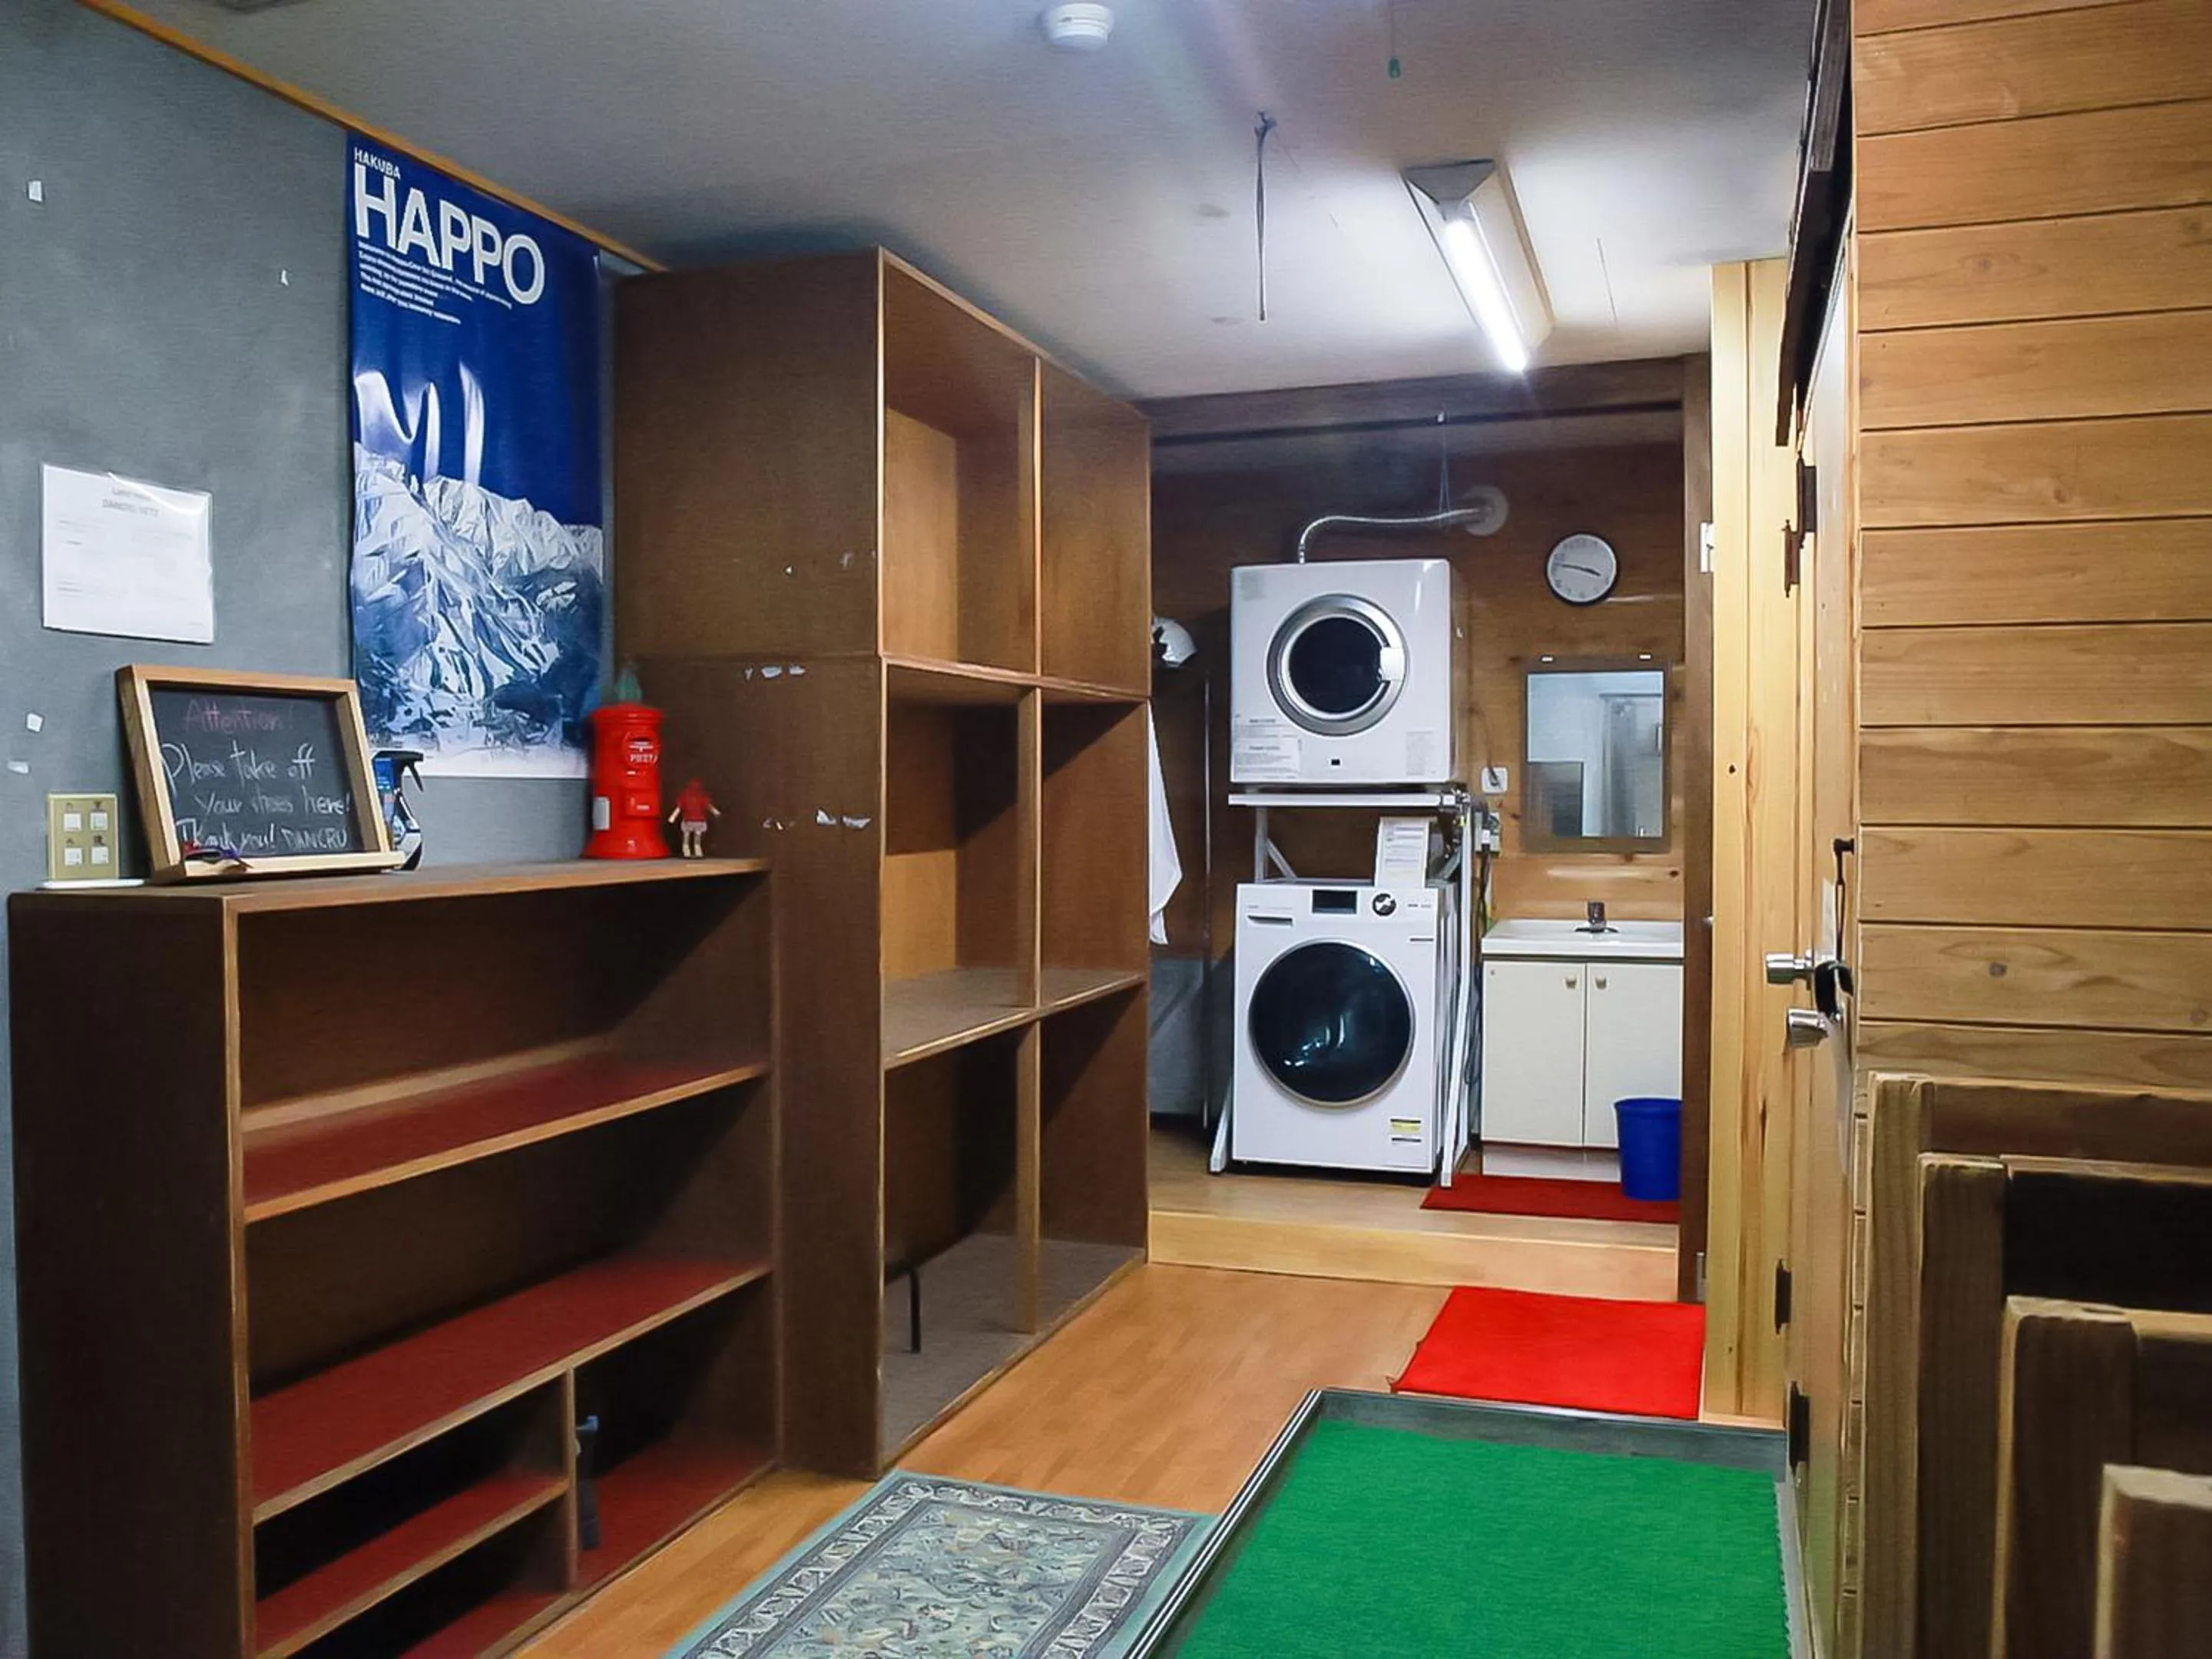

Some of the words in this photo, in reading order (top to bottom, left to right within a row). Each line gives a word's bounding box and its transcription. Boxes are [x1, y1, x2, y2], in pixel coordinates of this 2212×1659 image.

[355, 147, 401, 180] HAKUBA
[354, 164, 545, 305] HAPPO
[162, 743, 225, 795] Please
[229, 739, 277, 787] take
[287, 743, 316, 780] off
